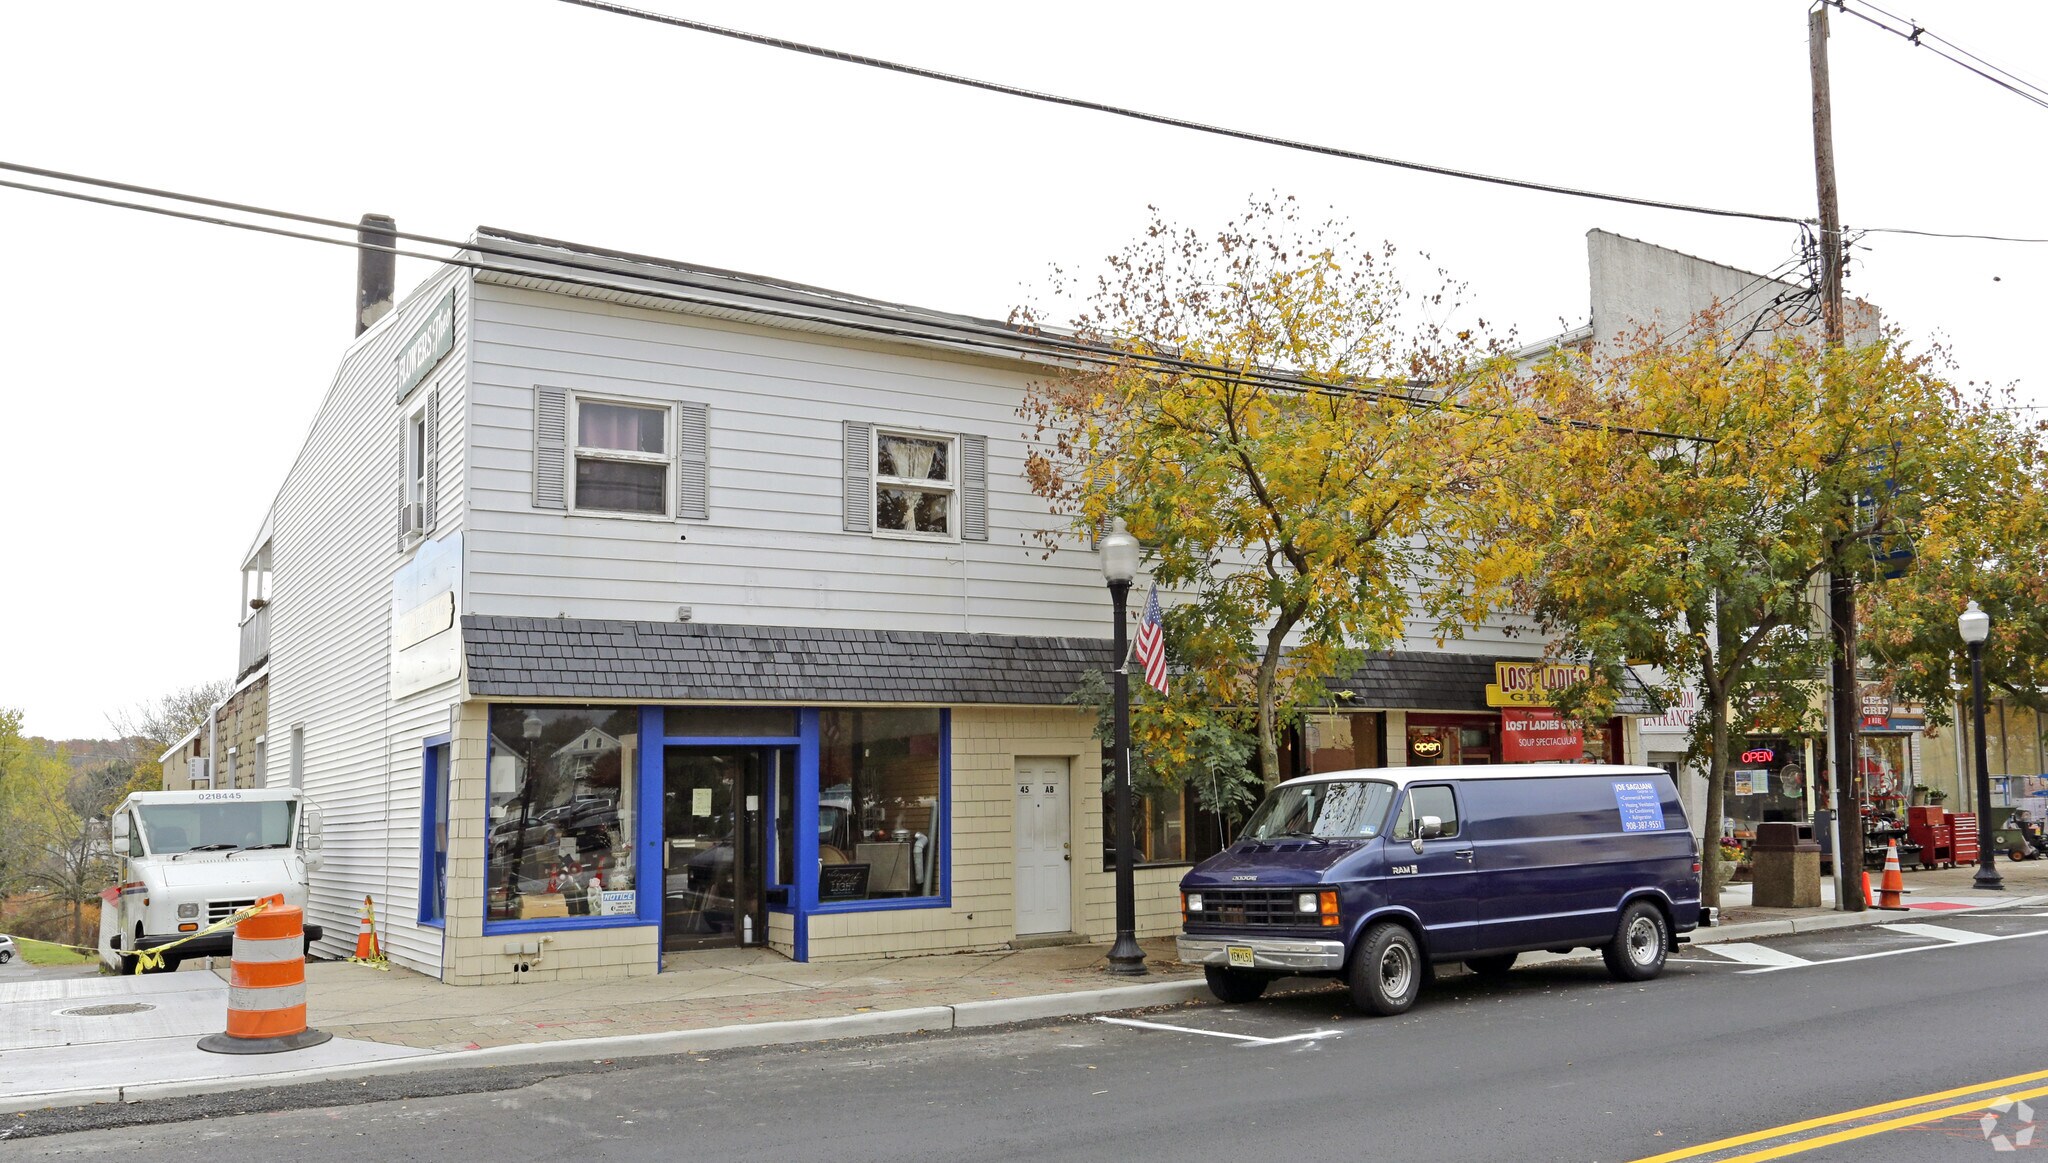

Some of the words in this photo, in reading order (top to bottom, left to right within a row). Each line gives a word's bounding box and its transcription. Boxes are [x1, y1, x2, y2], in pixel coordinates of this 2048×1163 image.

[399, 324, 432, 389] FLOWERS
[1500, 666, 1533, 692] LOST
[1541, 667, 1586, 691] LADIES
[1862, 706, 1889, 715] GRIP
[1505, 721, 1527, 731] LOST
[1529, 720, 1559, 731] LADIES
[1518, 738, 1535, 747] SOUP
[1536, 737, 1577, 747] SPECTACULAR
[1414, 742, 1441, 753] open
[1741, 751, 1773, 763] OPEN
[1020, 785, 1030, 794] 45
[1045, 785, 1054, 794] AB
[1615, 784, 1626, 792] JOE
[198, 792, 242, 800] 0218445
[1626, 820, 1662, 830] 908-387-9551
[1392, 866, 1410, 875] RAM
[604, 893, 633, 901] NOTICE
